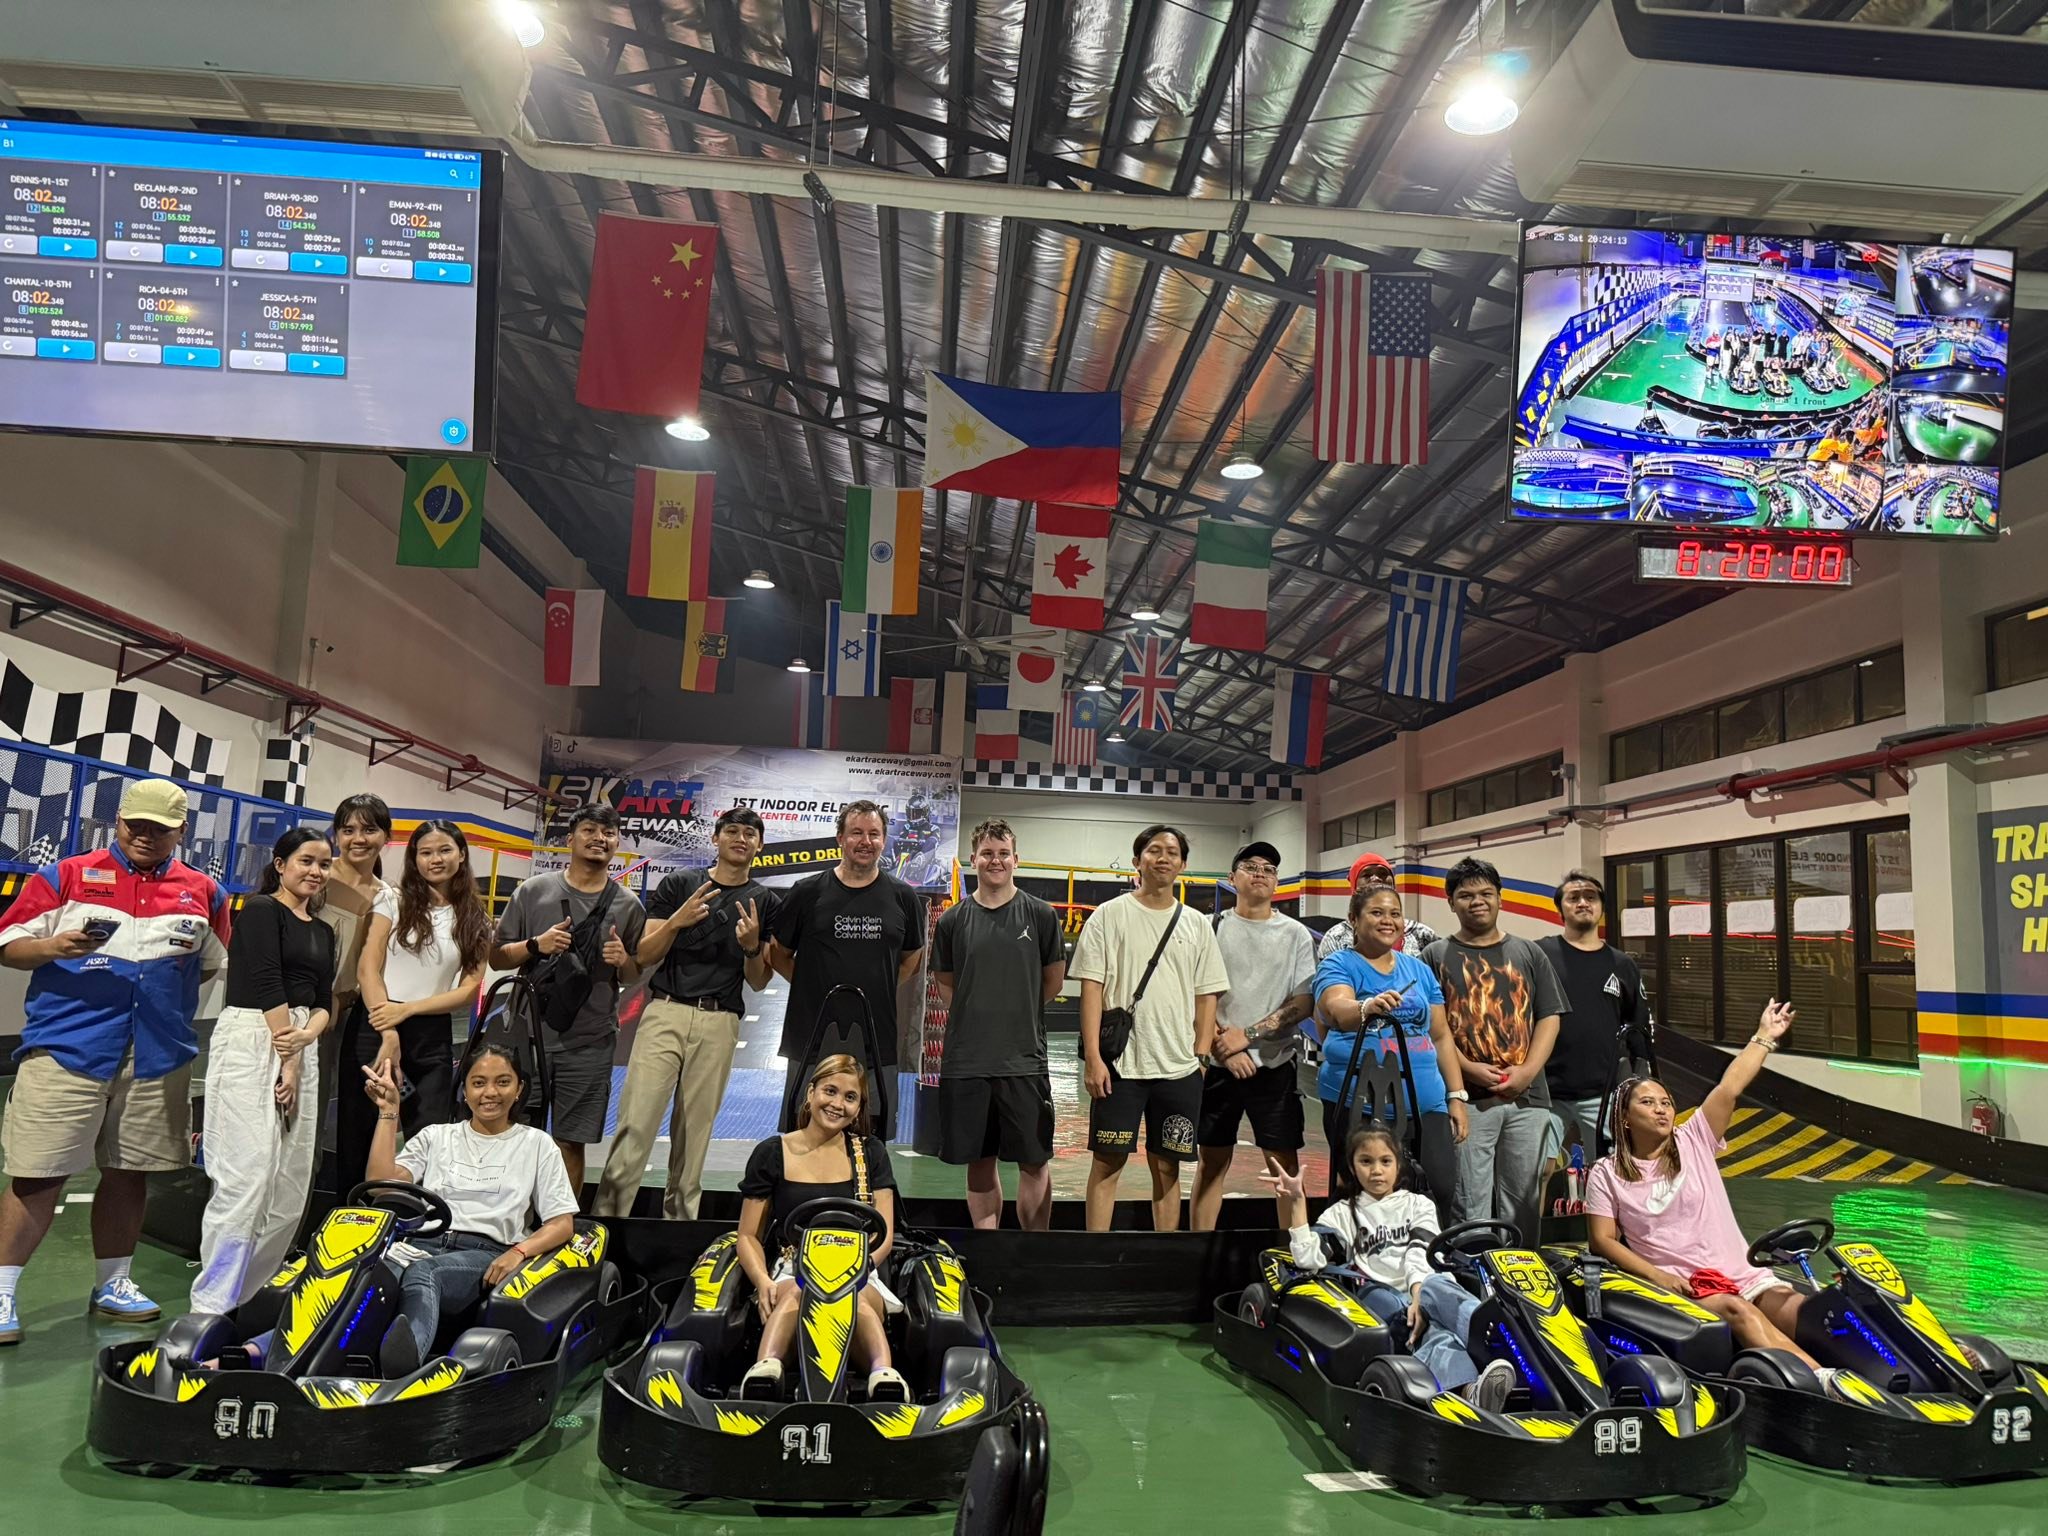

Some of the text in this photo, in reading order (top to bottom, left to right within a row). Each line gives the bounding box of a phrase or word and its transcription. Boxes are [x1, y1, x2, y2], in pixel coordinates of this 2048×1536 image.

[3, 138, 14, 148] B1
[10, 175, 69, 186] DENNIS-91-1ST
[134, 183, 198, 195] DECLAN-89-2ND
[264, 192, 319, 203] BRIAN-90-3RD
[389, 201, 442, 211] EMAN-92-4TH
[115, 221, 124, 229] 12
[390, 213, 441, 228] 08:02.348
[240, 239, 248, 247] 12
[1568, 233, 1583, 242] Sat
[1587, 234, 1627, 244] 20:24:13
[4, 277, 72, 288] CHANTAL-10-5TH
[139, 285, 188, 295] RICA-04-6TH
[260, 294, 317, 304] JESSICA-5-7TH
[263, 305, 315, 320] 08:02.348
[1676, 541, 1844, 582] 8:28:00
[845, 755, 952, 768] ekartraceway@gmail.com
[875, 768, 951, 779] ekartraceway.com
[733, 797, 757, 808] 1ST
[760, 799, 816, 812] INDOOR
[761, 813, 798, 822] CENTER
[800, 814, 811, 822] IN
[813, 814, 832, 823] THE
[789, 851, 810, 863] TO
[834, 915, 861, 923] Calvin
[834, 922, 882, 931] Calvin Klein
[834, 930, 882, 939] Calvin Klein
[1594, 1416, 1642, 1456] 89
